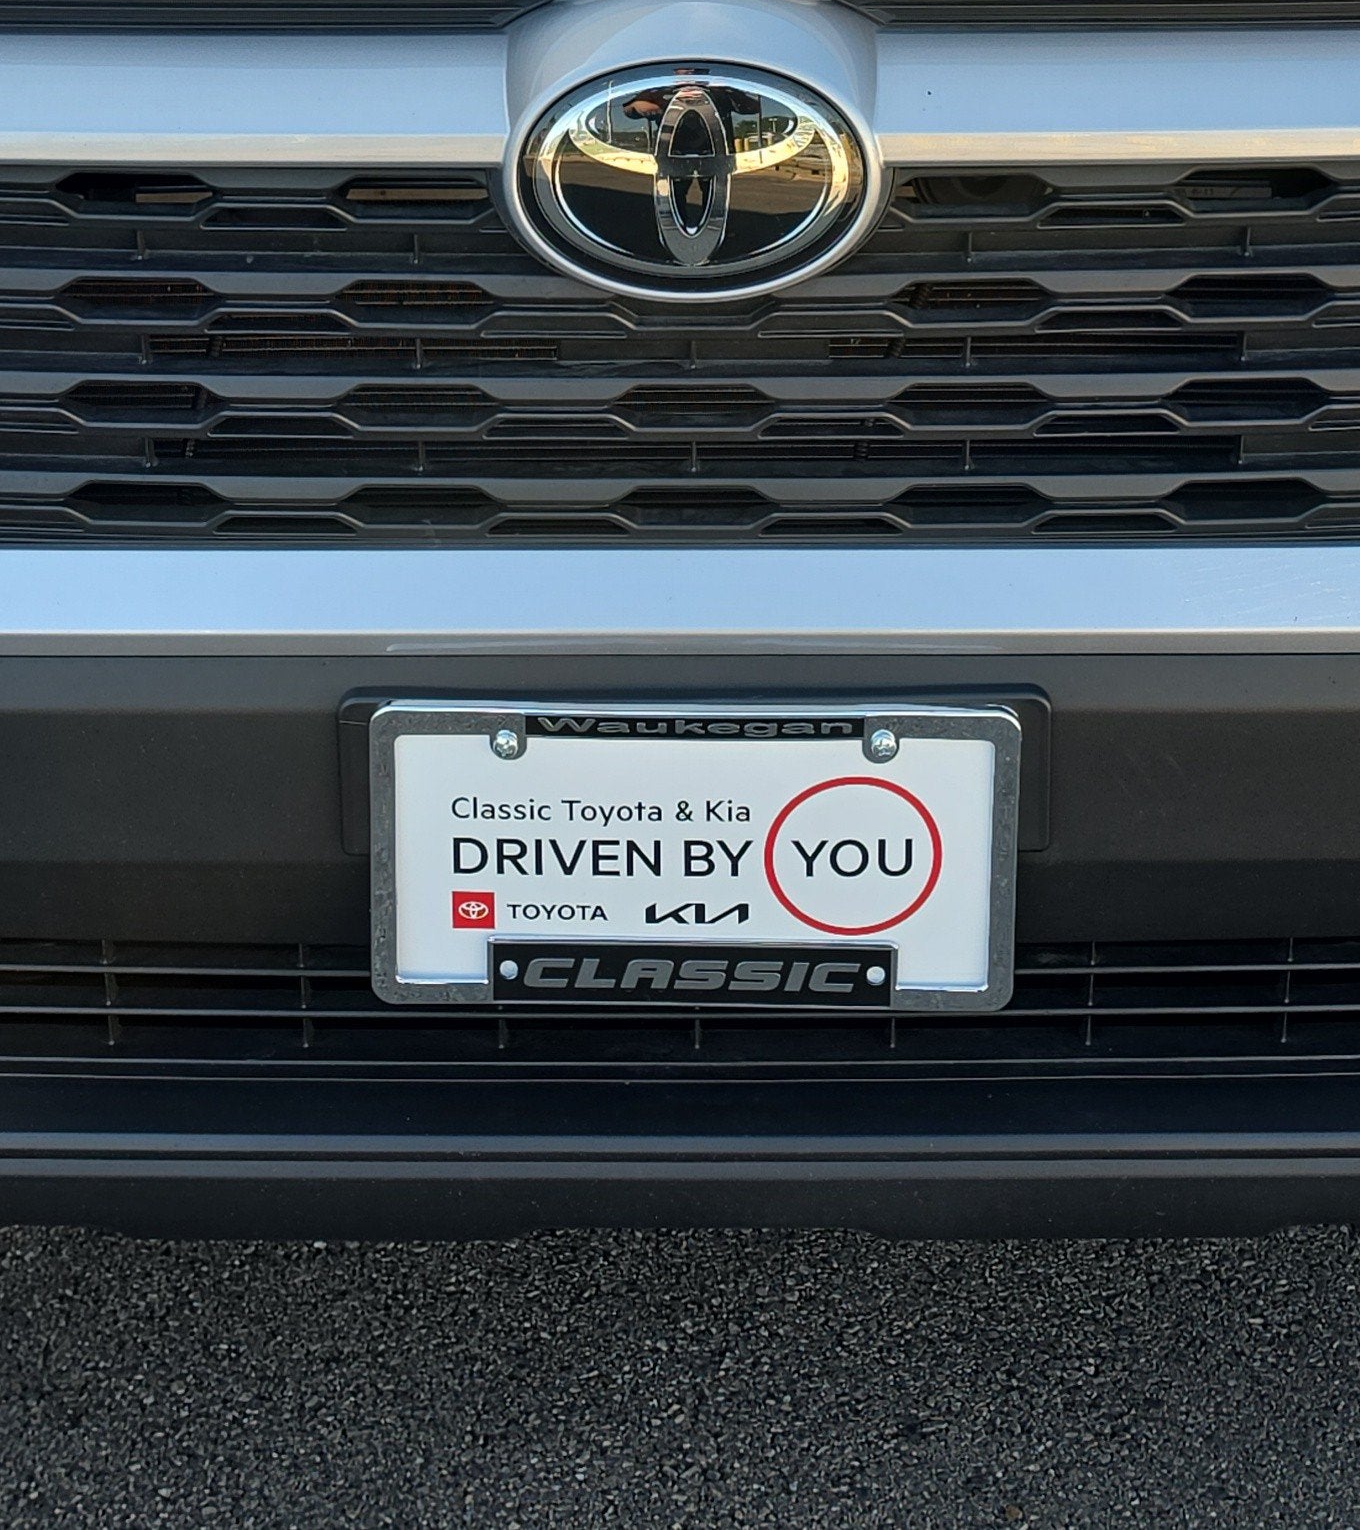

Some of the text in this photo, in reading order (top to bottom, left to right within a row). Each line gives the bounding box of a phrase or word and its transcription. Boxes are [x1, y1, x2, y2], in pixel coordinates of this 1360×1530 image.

[537, 717, 853, 737] Waukegan
[451, 797, 751, 827] Classic Toyota & Kia
[452, 837, 914, 877] DRIVEN BY YOU
[507, 904, 608, 921] TOYOTA
[523, 958, 861, 992] CLASSIC
